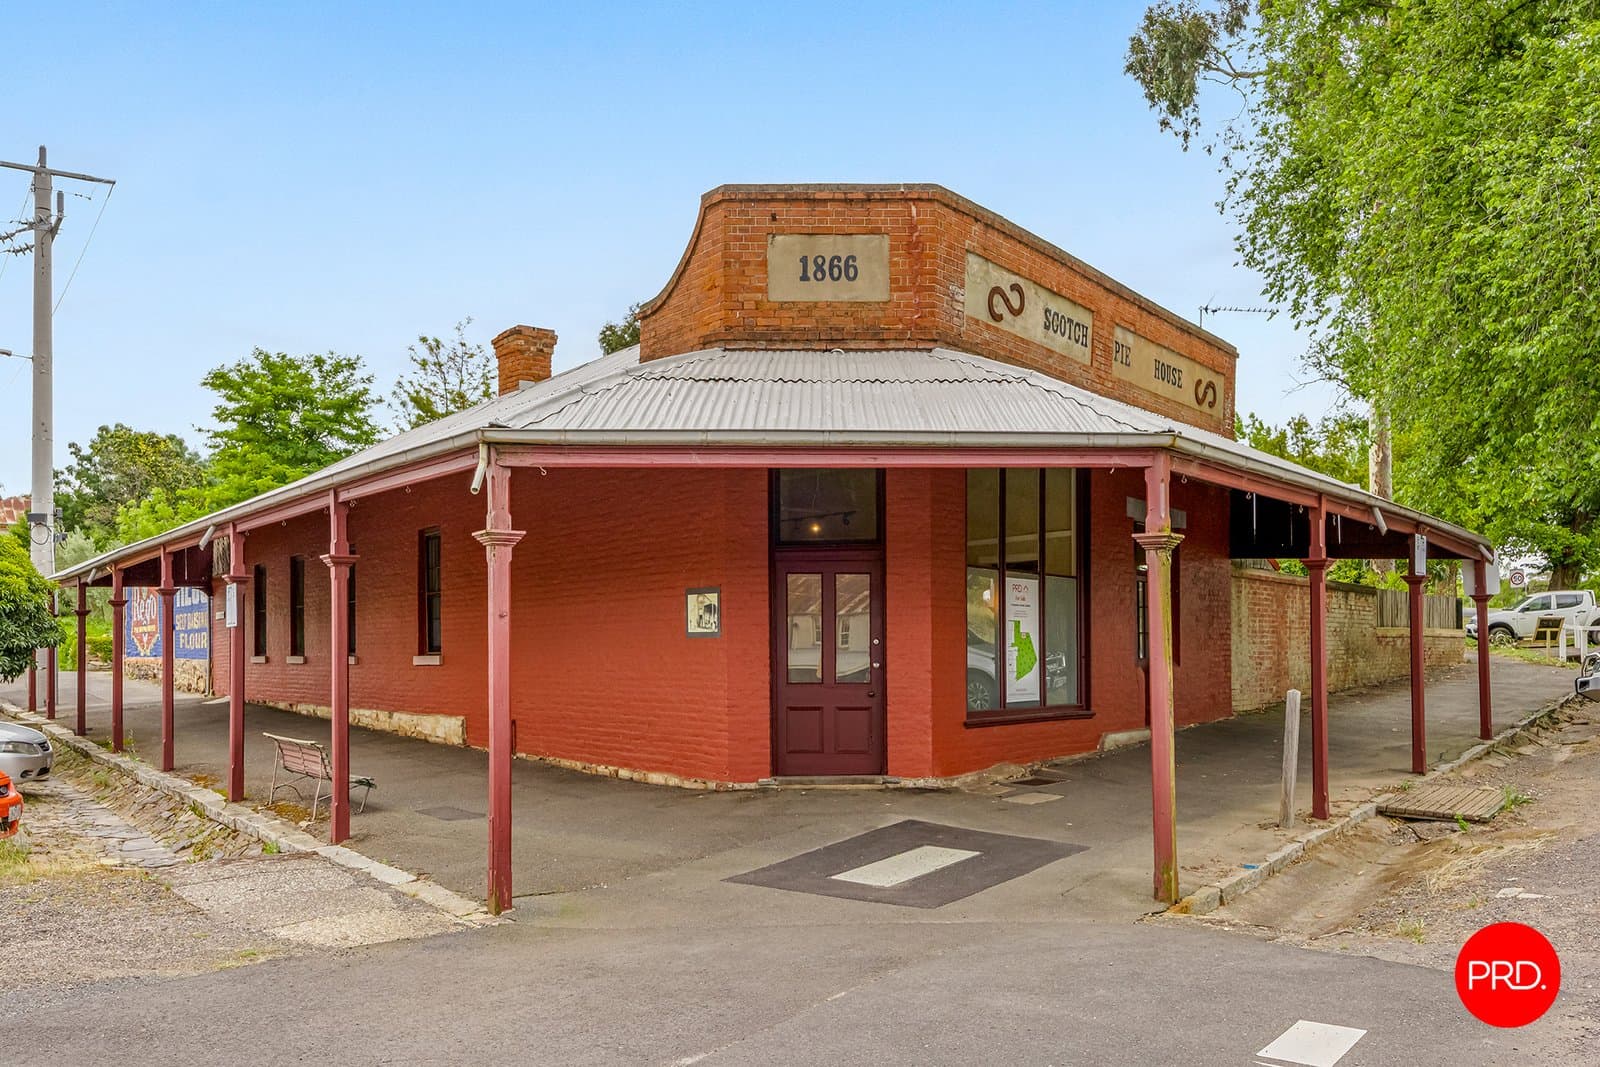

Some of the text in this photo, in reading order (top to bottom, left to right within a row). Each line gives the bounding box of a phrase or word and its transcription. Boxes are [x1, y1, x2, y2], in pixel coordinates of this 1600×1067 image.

[799, 255, 858, 281] 1866
[1043, 307, 1183, 389] SCOTCH PIE HOUSE
[179, 632, 207, 649] FLOUR
